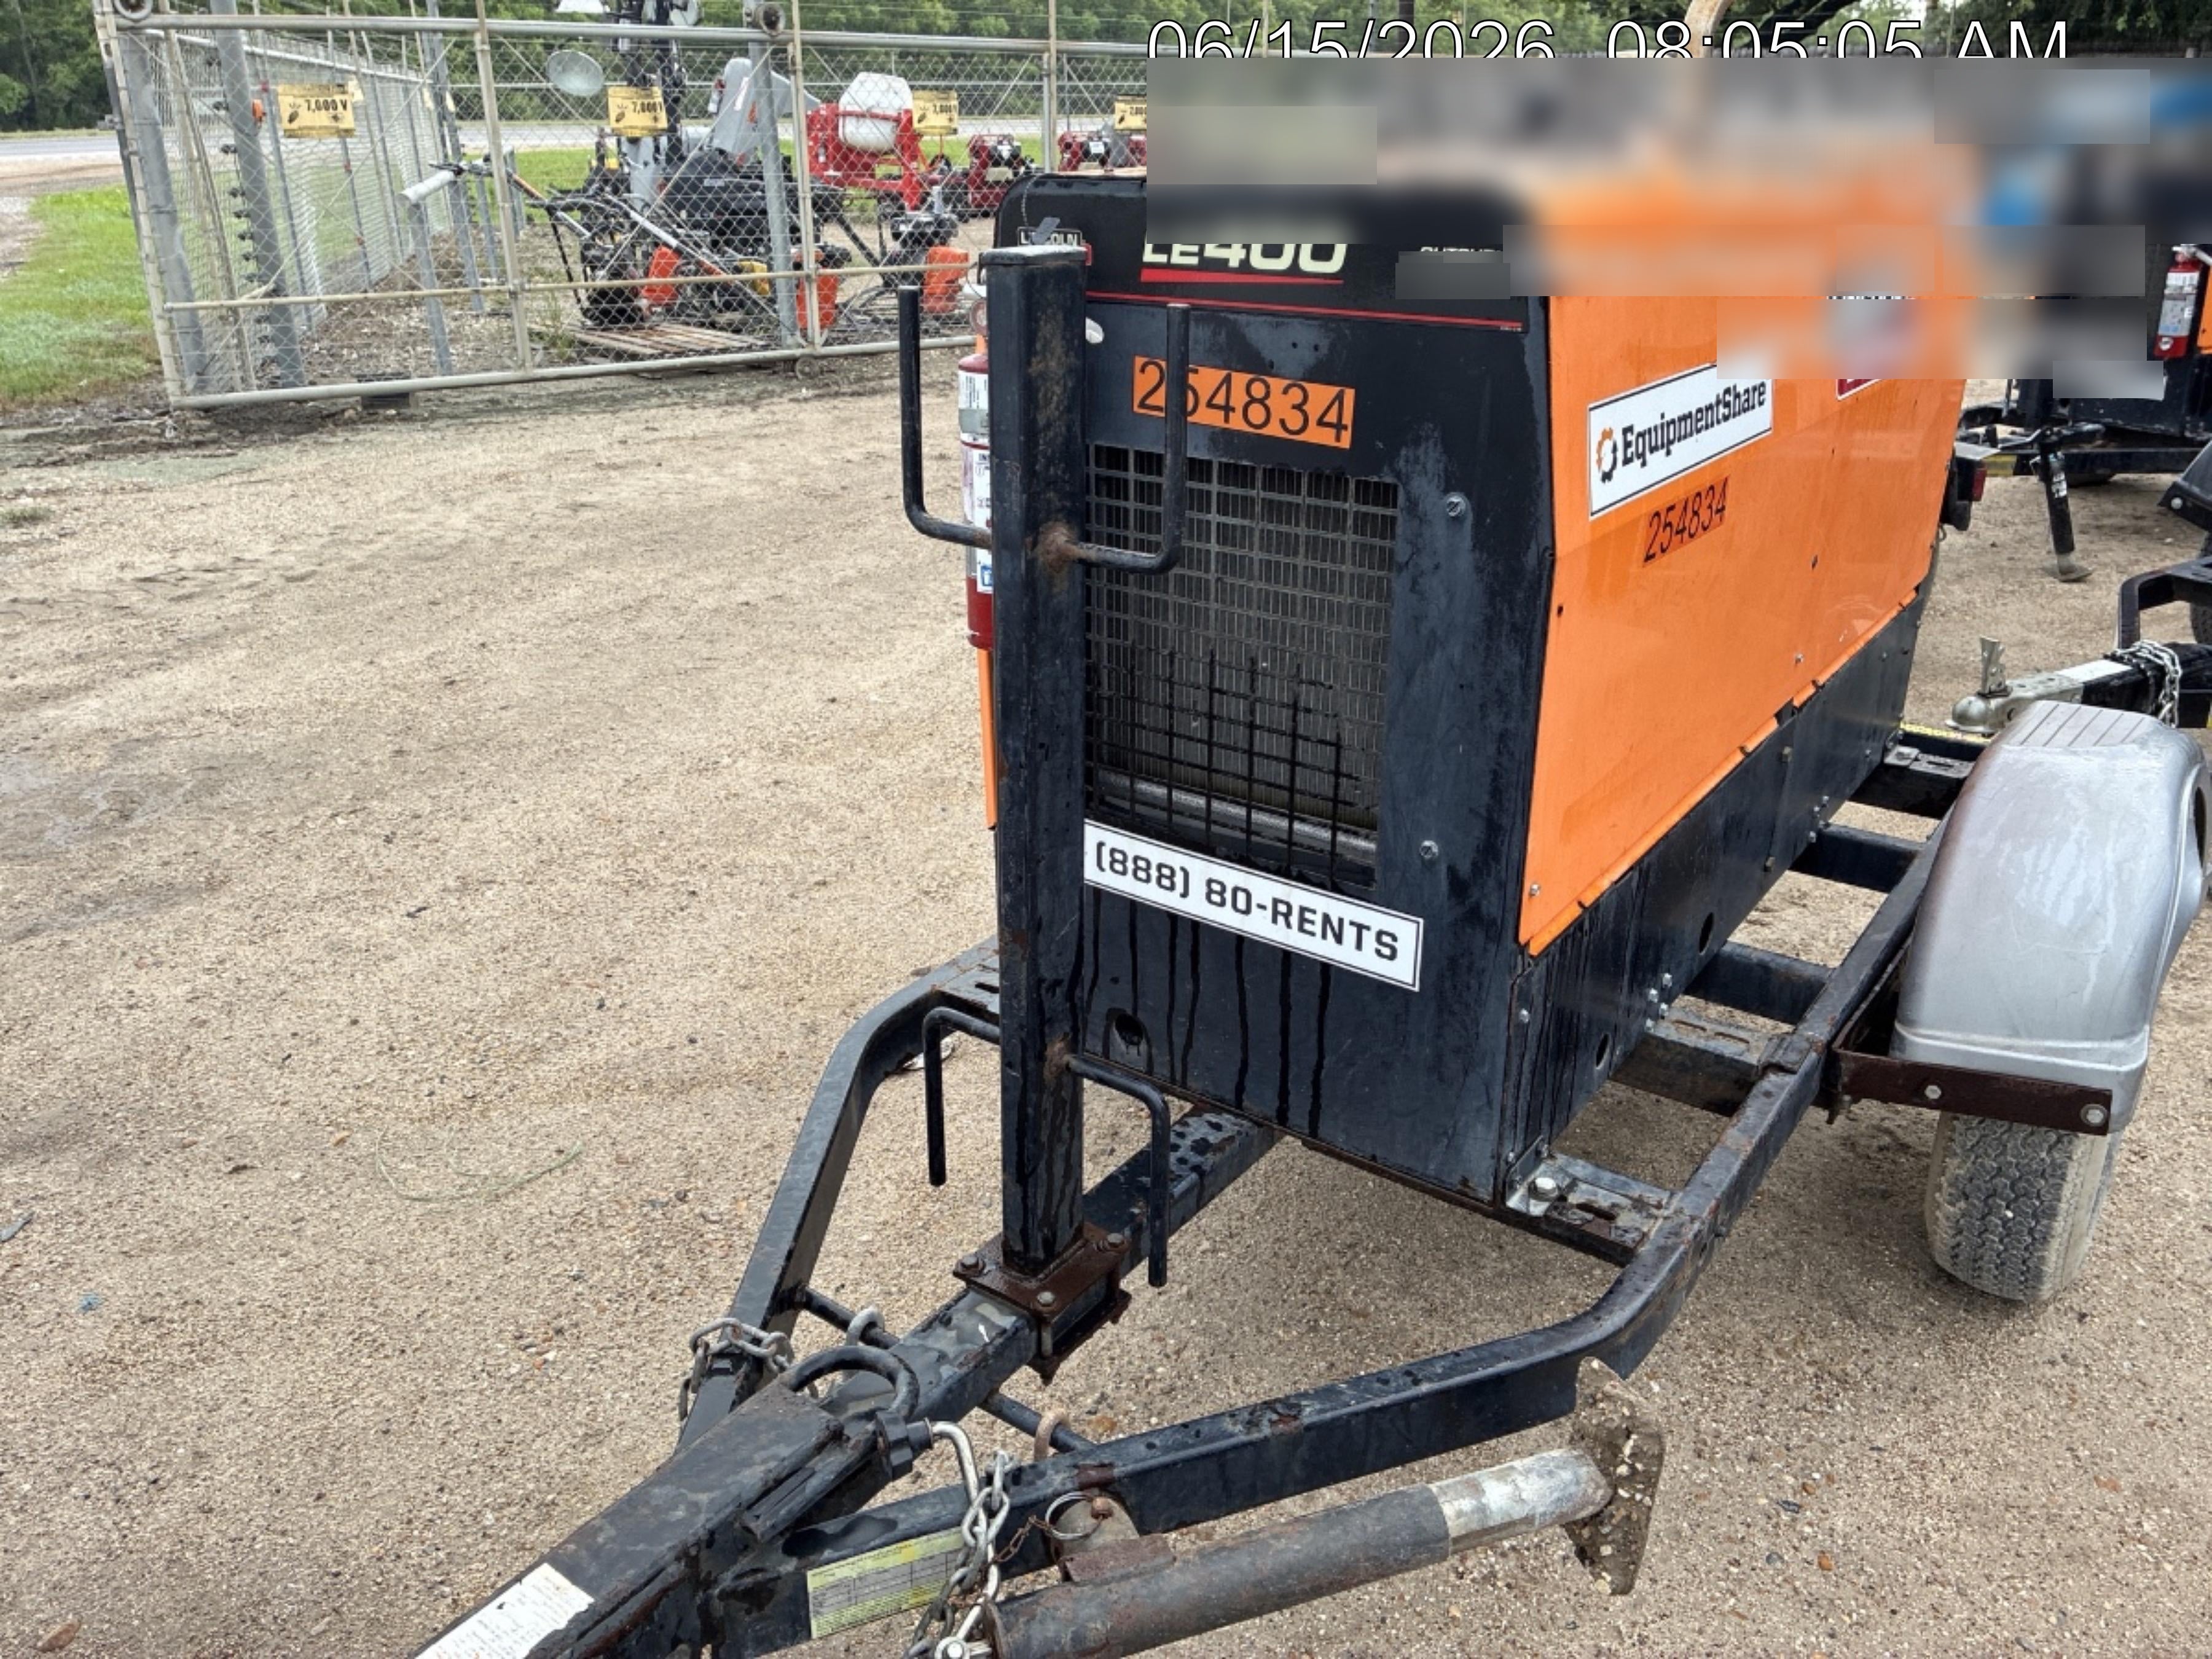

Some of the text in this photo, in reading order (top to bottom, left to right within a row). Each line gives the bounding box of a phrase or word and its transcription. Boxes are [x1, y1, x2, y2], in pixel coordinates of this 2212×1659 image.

[305, 99, 338, 112] 7,000
[1021, 231, 1078, 246] LOLN
[1622, 380, 1767, 468] EquipmentShare
[1643, 475, 1729, 563] 254834
[1096, 840, 1399, 962] (888) 80-RENTS
